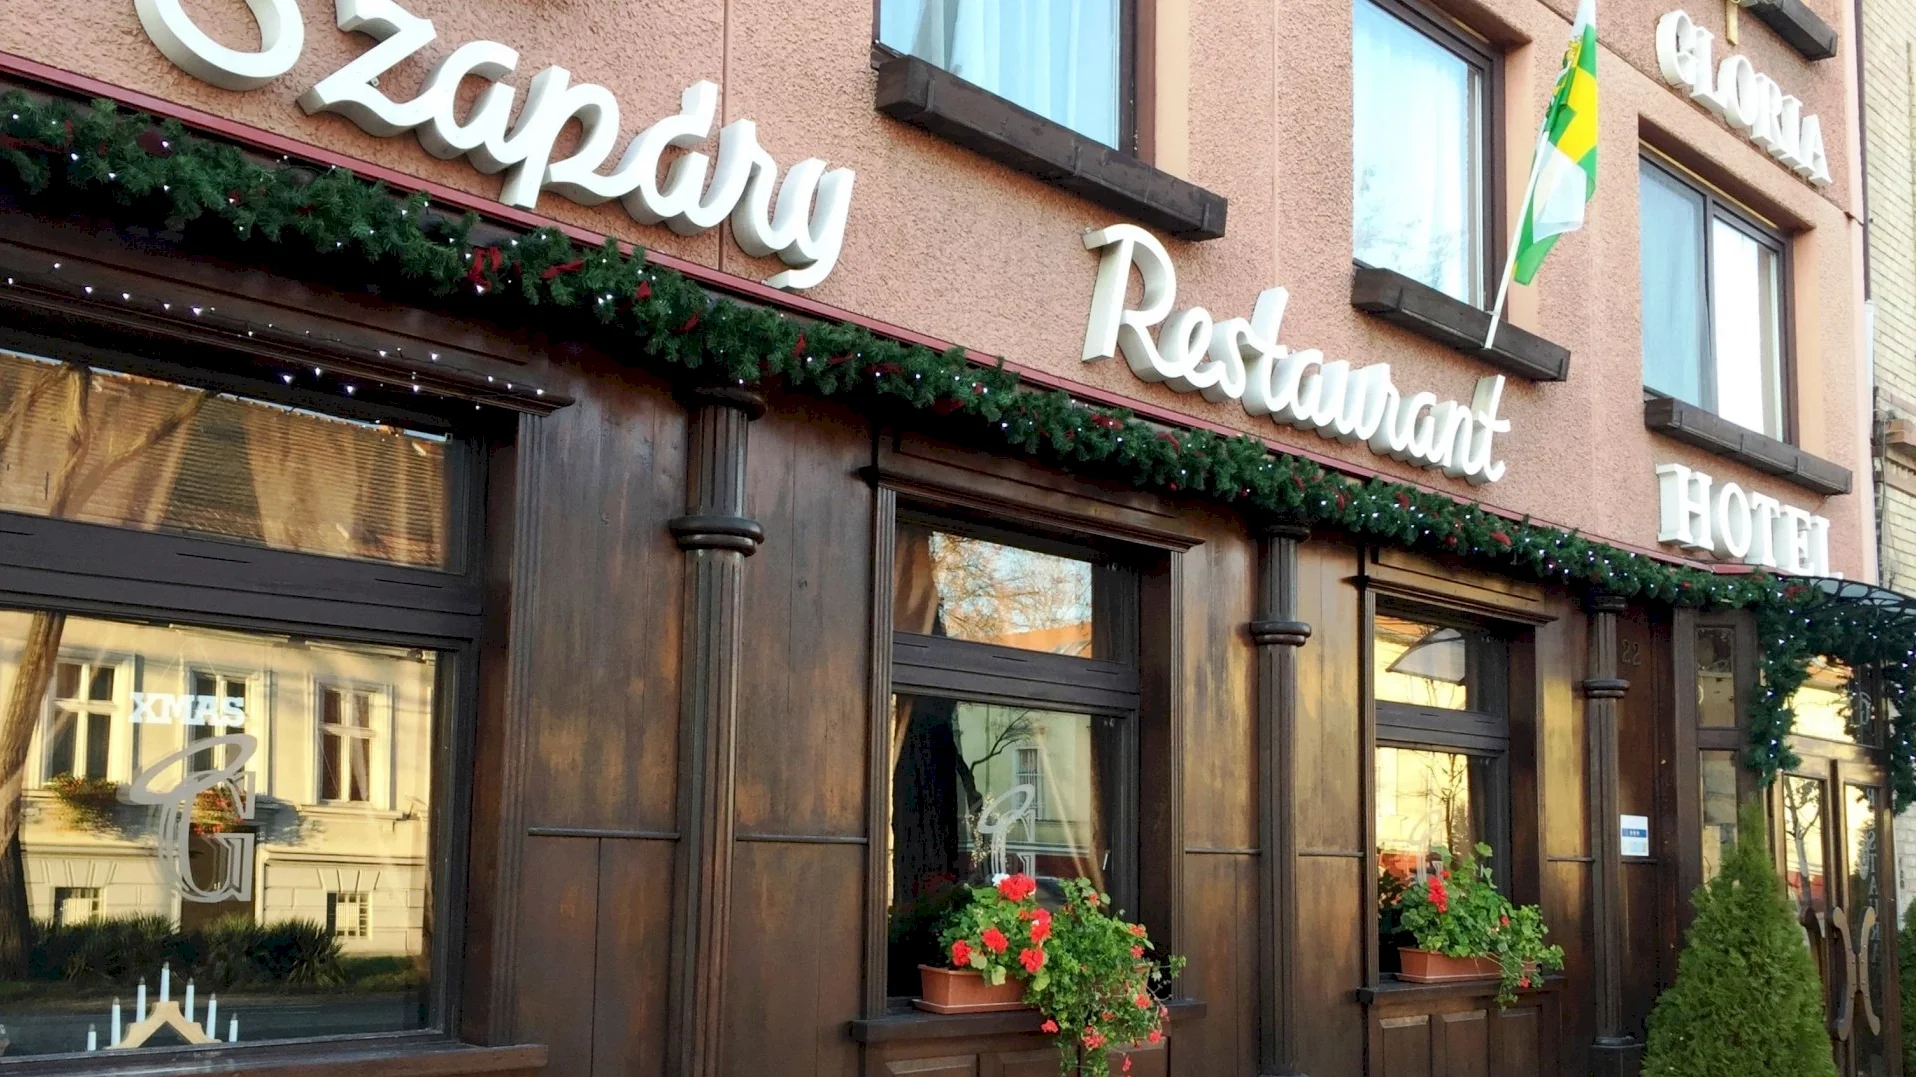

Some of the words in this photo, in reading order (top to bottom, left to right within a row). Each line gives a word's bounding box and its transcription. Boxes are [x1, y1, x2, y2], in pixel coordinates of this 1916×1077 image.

[1655, 9, 1833, 185] GLORIA
[1081, 223, 1511, 487] Restaurant
[1656, 463, 1843, 580] HOTEL
[129, 691, 246, 728] XMAS
[1621, 639, 1641, 666] 22
